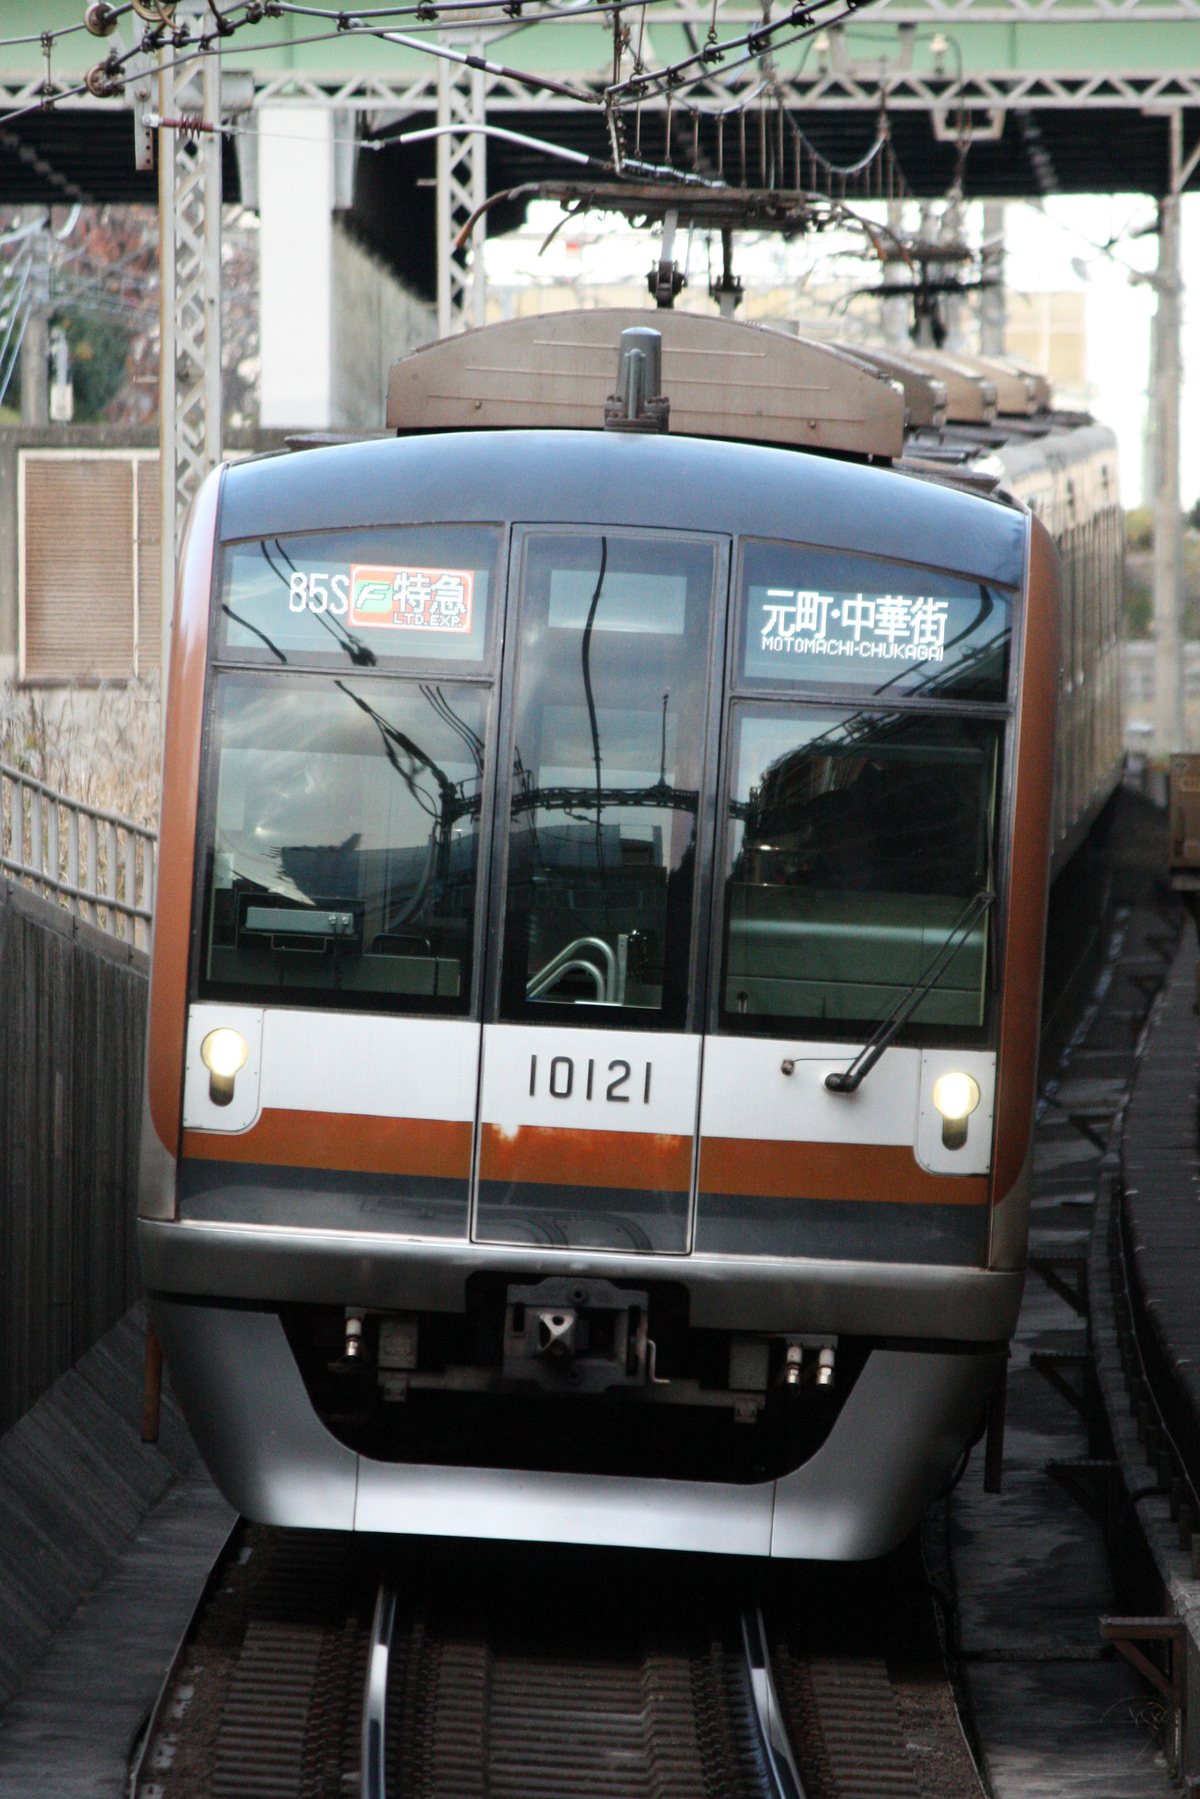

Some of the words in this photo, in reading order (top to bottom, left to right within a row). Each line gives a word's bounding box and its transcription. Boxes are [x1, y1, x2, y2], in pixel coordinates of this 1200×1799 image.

[289, 572, 350, 615] 85S
[393, 571, 468, 616] 特急
[761, 636, 945, 662] MOTOMACHI-CHUKAGAI
[529, 1054, 652, 1104] 10121
